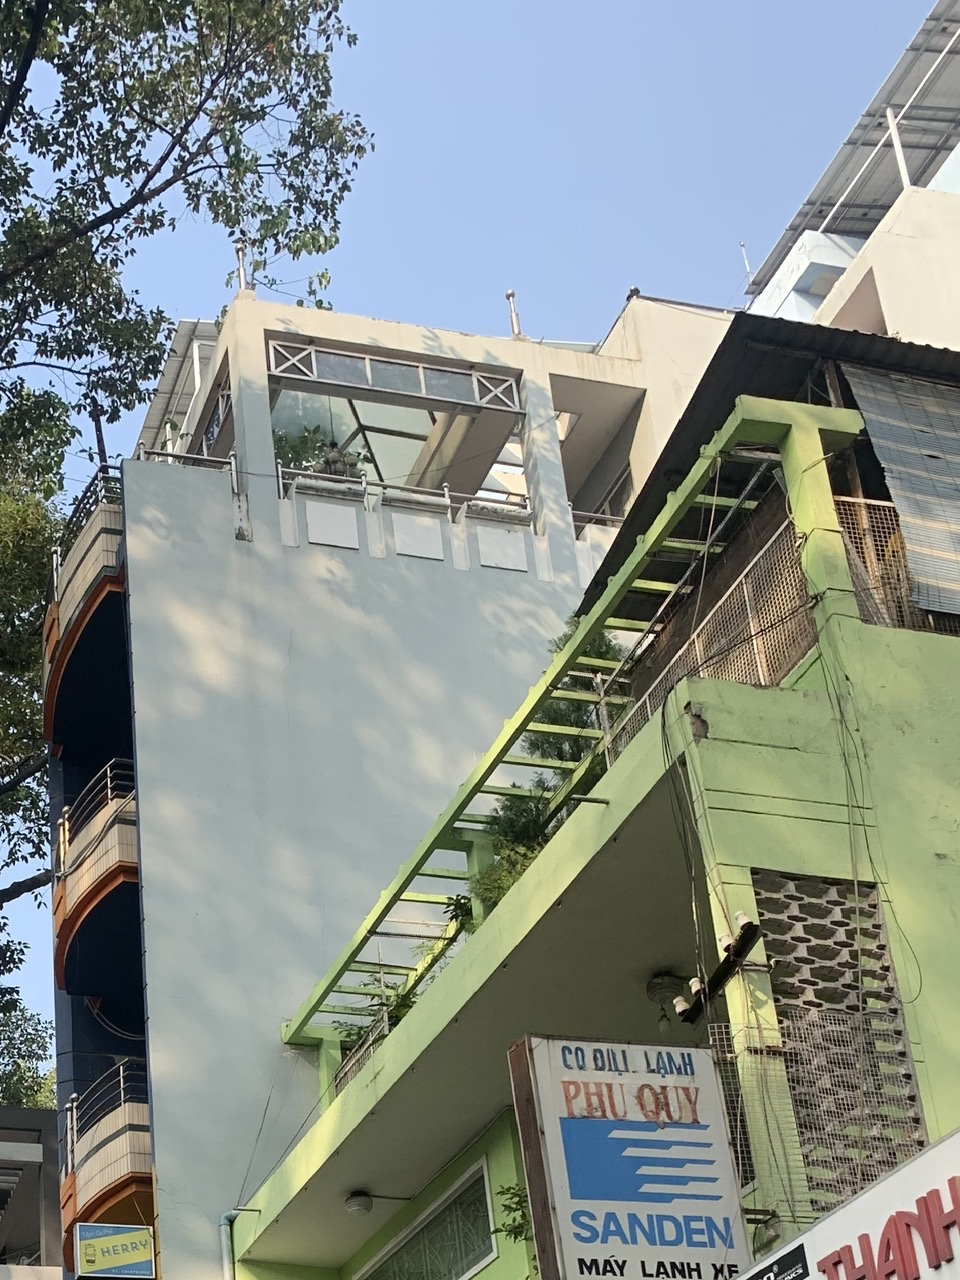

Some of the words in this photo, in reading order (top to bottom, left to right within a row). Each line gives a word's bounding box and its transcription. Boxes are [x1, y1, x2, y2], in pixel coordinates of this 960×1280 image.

[571, 1209, 735, 1249] SANDEN
[100, 1239, 148, 1257] HERRY
[577, 1255, 628, 1277] MÁY
[640, 1260, 703, 1280] LẠNH
